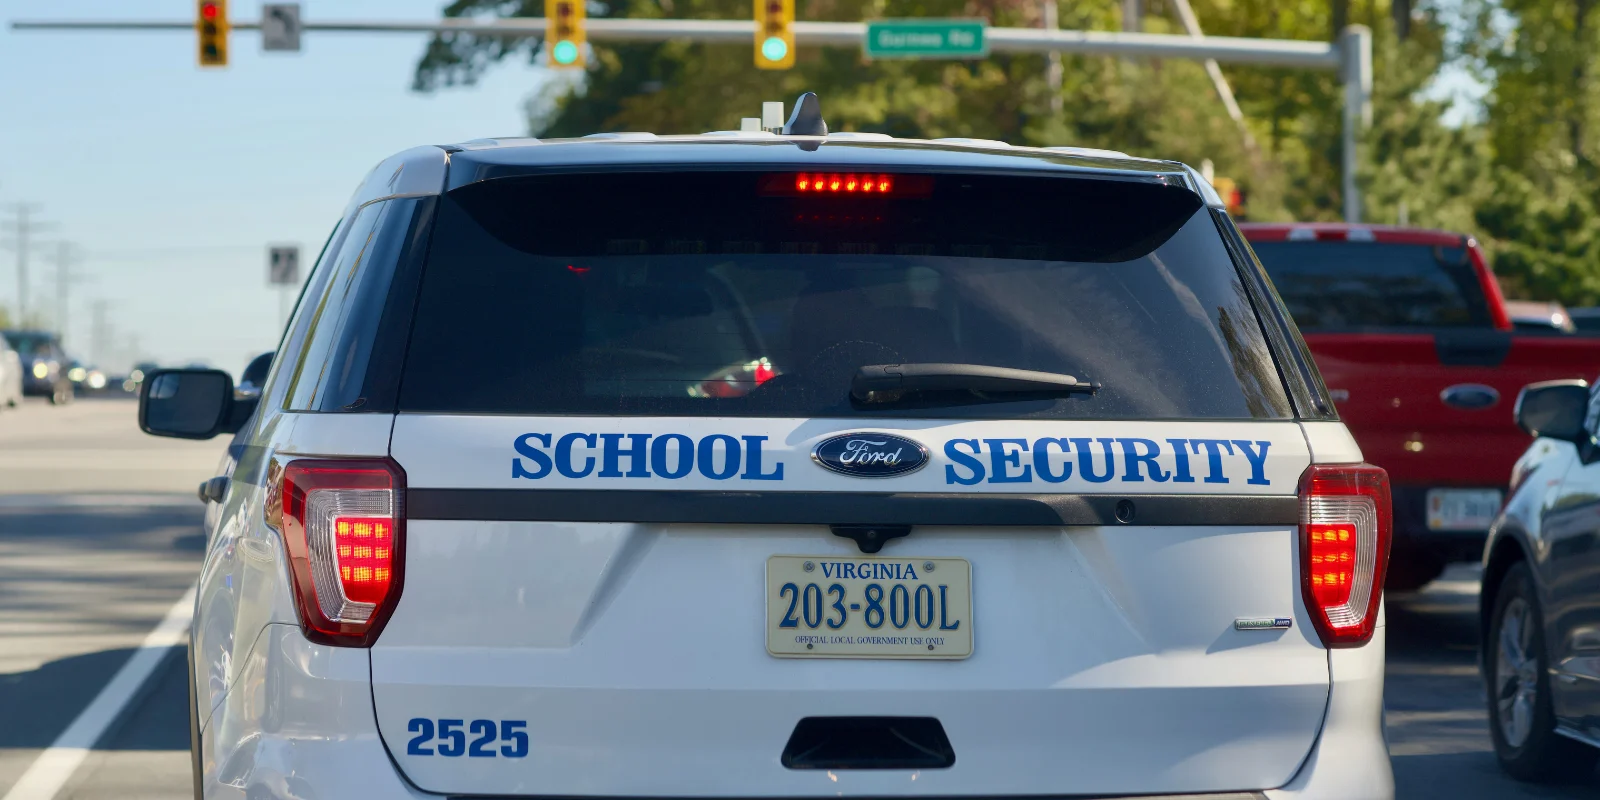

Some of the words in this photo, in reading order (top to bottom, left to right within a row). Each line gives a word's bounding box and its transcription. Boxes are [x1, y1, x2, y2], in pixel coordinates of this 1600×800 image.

[512, 432, 784, 481] SCHOOL
[943, 436, 1272, 486] SECURITY
[839, 438, 903, 466] Ford
[820, 562, 918, 580] VIRGINIA
[779, 582, 960, 630] 203-800L
[794, 635, 828, 645] OFFICIAL
[830, 636, 856, 645] LOCAL
[857, 636, 908, 646] GOVERNMENT
[910, 637, 924, 646] USE
[925, 637, 945, 646] ONLY
[407, 717, 529, 759] 2525
